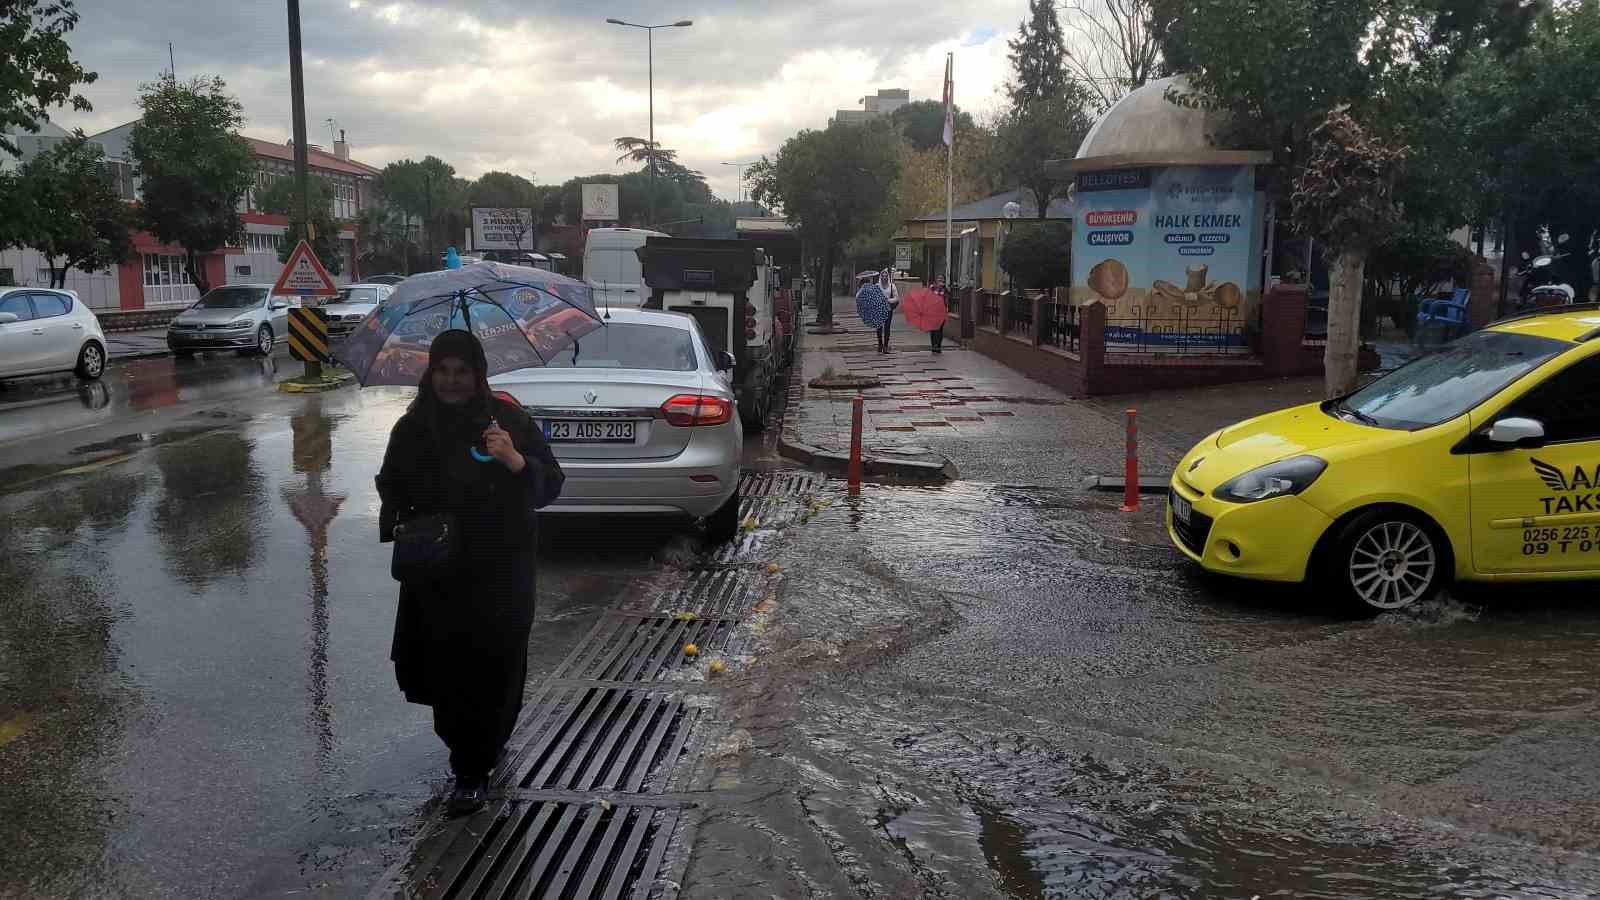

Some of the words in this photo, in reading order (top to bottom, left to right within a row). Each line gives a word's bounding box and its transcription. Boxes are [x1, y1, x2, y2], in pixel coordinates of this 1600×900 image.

[1155, 214, 1190, 228] HALK
[1193, 213, 1241, 228] EKMEK
[552, 423, 570, 438] 23
[575, 423, 602, 438] ADS
[606, 423, 632, 438] 203
[1523, 529, 1558, 543] 0256
[1563, 527, 1589, 541] 225
[1521, 542, 1549, 556] 09
[1557, 541, 1572, 553] T
